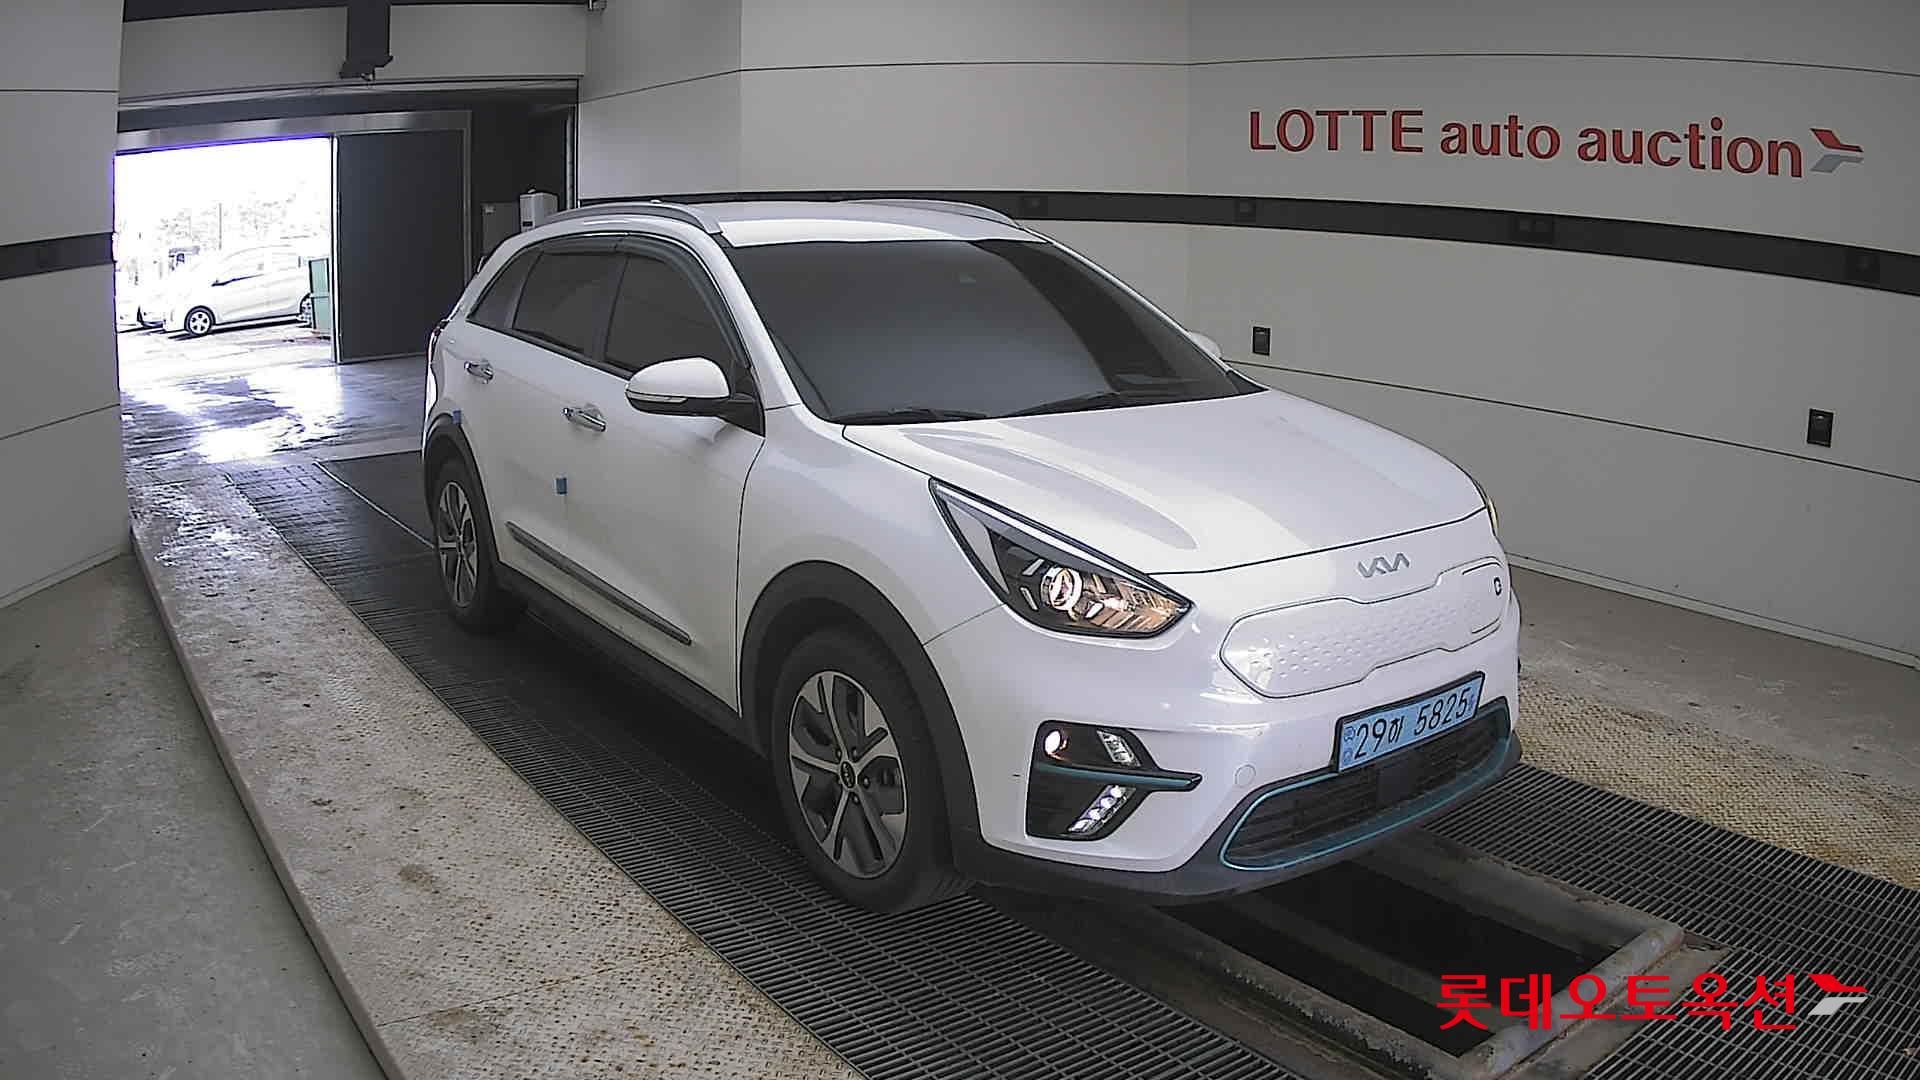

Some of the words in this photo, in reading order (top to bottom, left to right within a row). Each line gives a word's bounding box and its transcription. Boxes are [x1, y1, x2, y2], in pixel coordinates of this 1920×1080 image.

[1249, 110, 1424, 153] LOTTE
[1440, 114, 1561, 160] auto
[1577, 117, 1803, 178] auction
[1358, 553, 1410, 578] KIA
[1414, 687, 1471, 736] 5825
